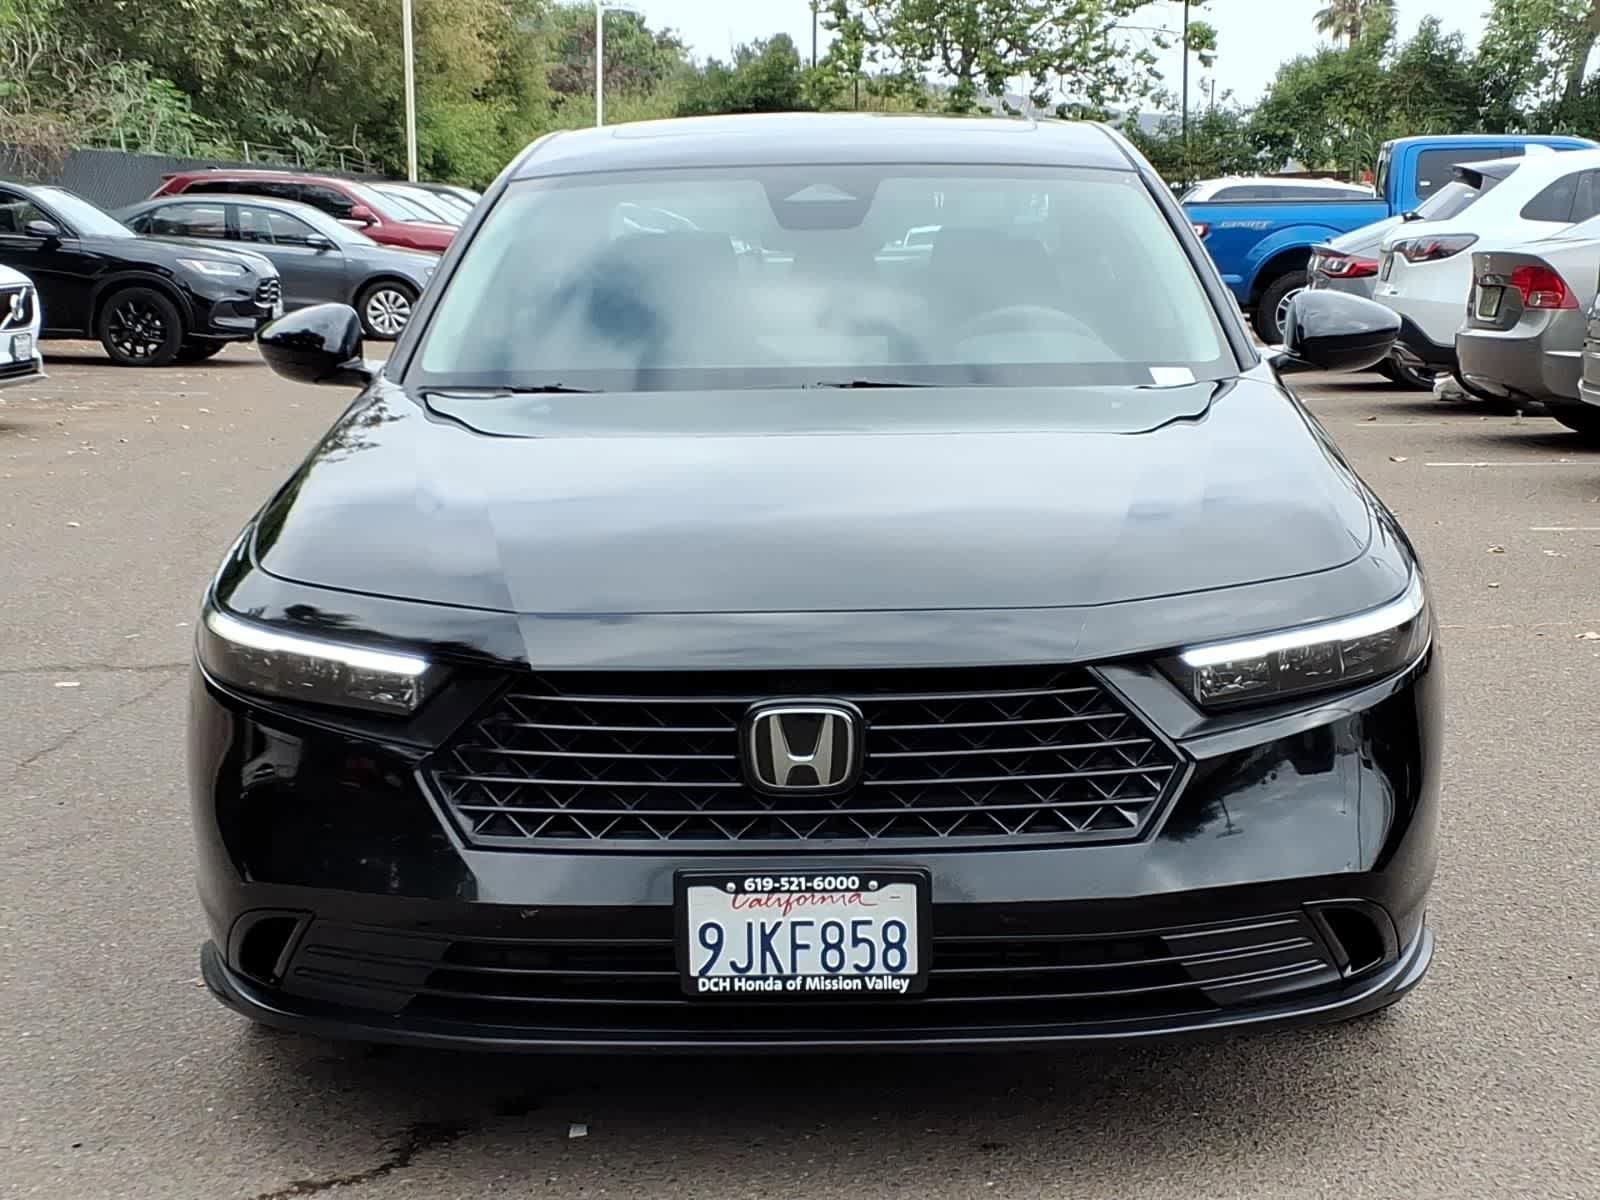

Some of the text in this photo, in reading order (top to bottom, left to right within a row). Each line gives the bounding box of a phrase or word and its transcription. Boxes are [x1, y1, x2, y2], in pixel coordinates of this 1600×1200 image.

[744, 876, 860, 891] 619-521-6000
[732, 891, 878, 916] California
[698, 919, 907, 976] 9JKF858
[698, 975, 909, 994] DCH Honda of Mission Valley
